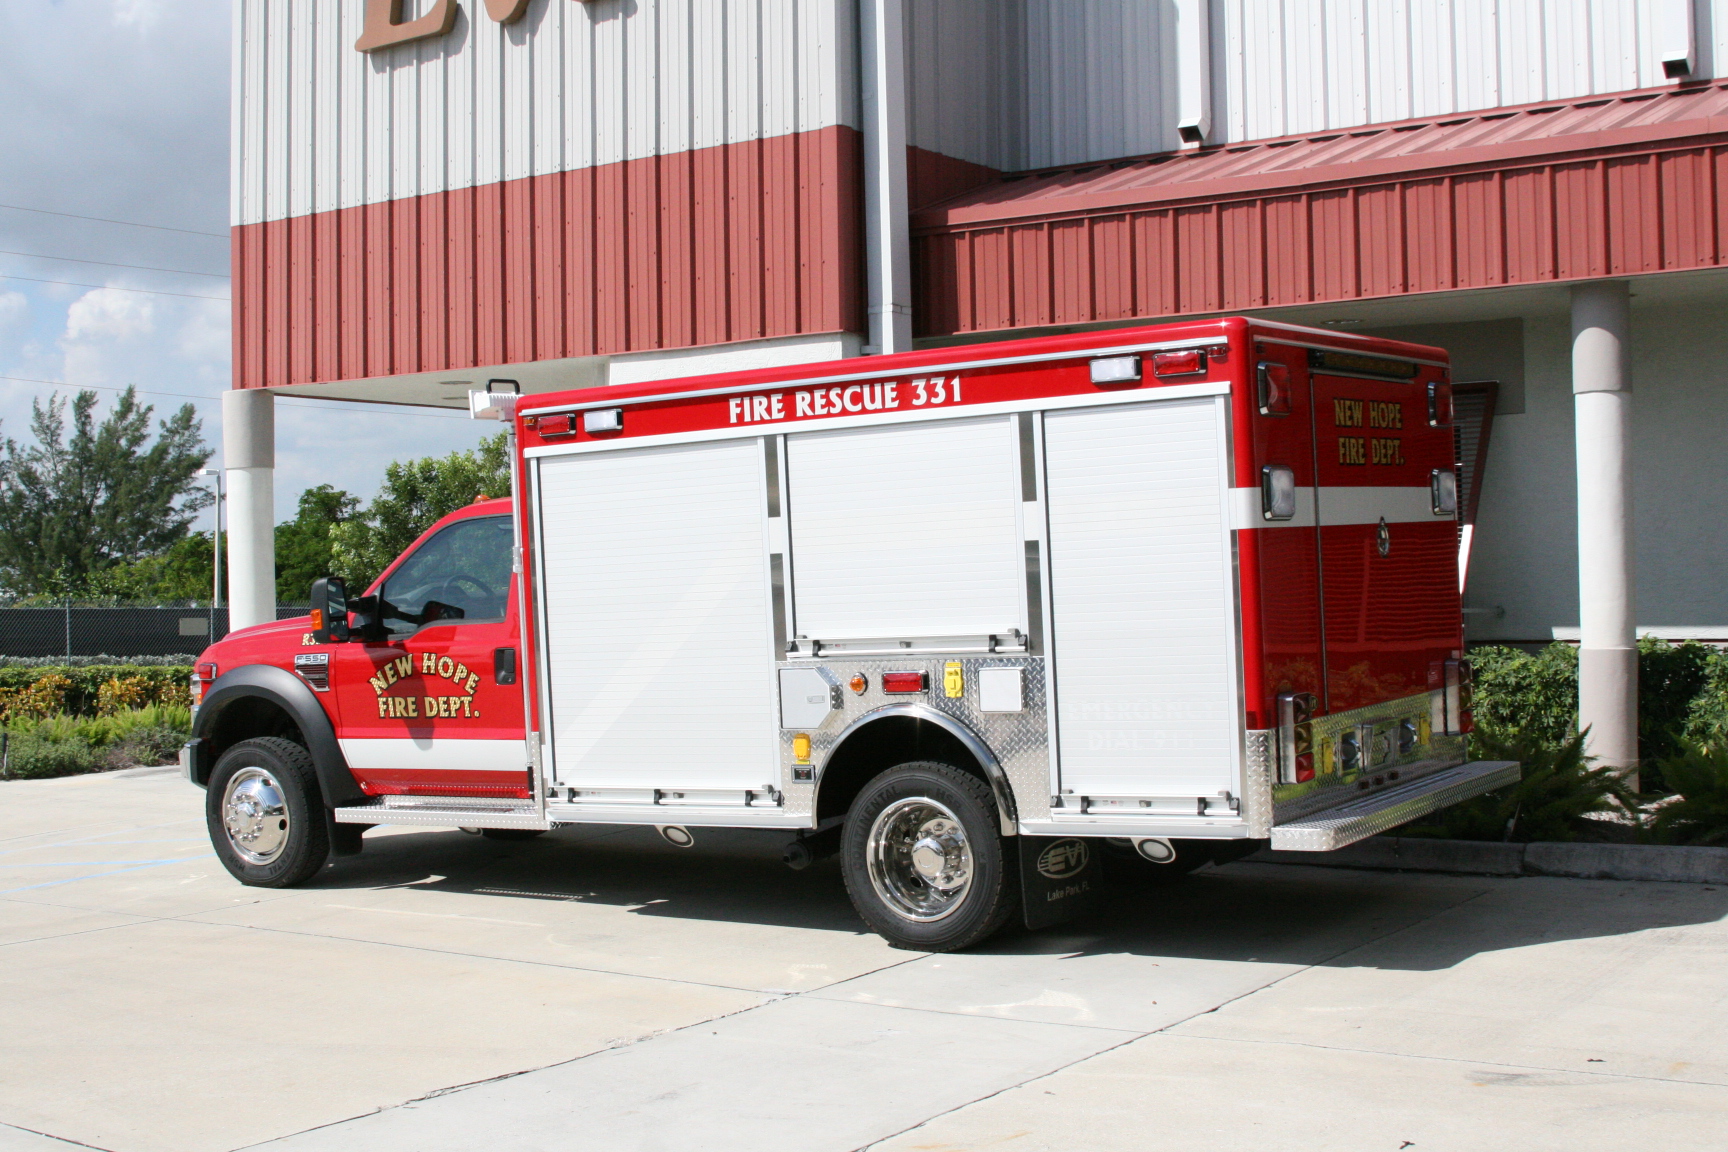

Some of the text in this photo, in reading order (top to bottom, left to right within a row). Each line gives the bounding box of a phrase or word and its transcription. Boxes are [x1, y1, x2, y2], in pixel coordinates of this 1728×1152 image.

[729, 375, 961, 423] FIRE RESCUE 331
[1333, 398, 1403, 430] NEW HOPE
[1338, 436, 1405, 466] FIRE DEPT.
[368, 651, 481, 696] NEW HOPE
[377, 696, 481, 719] FIRE DEPT.
[1087, 729, 1194, 750] DIAL 911
[1047, 889, 1064, 902] Lake
[1082, 881, 1090, 891] FL
